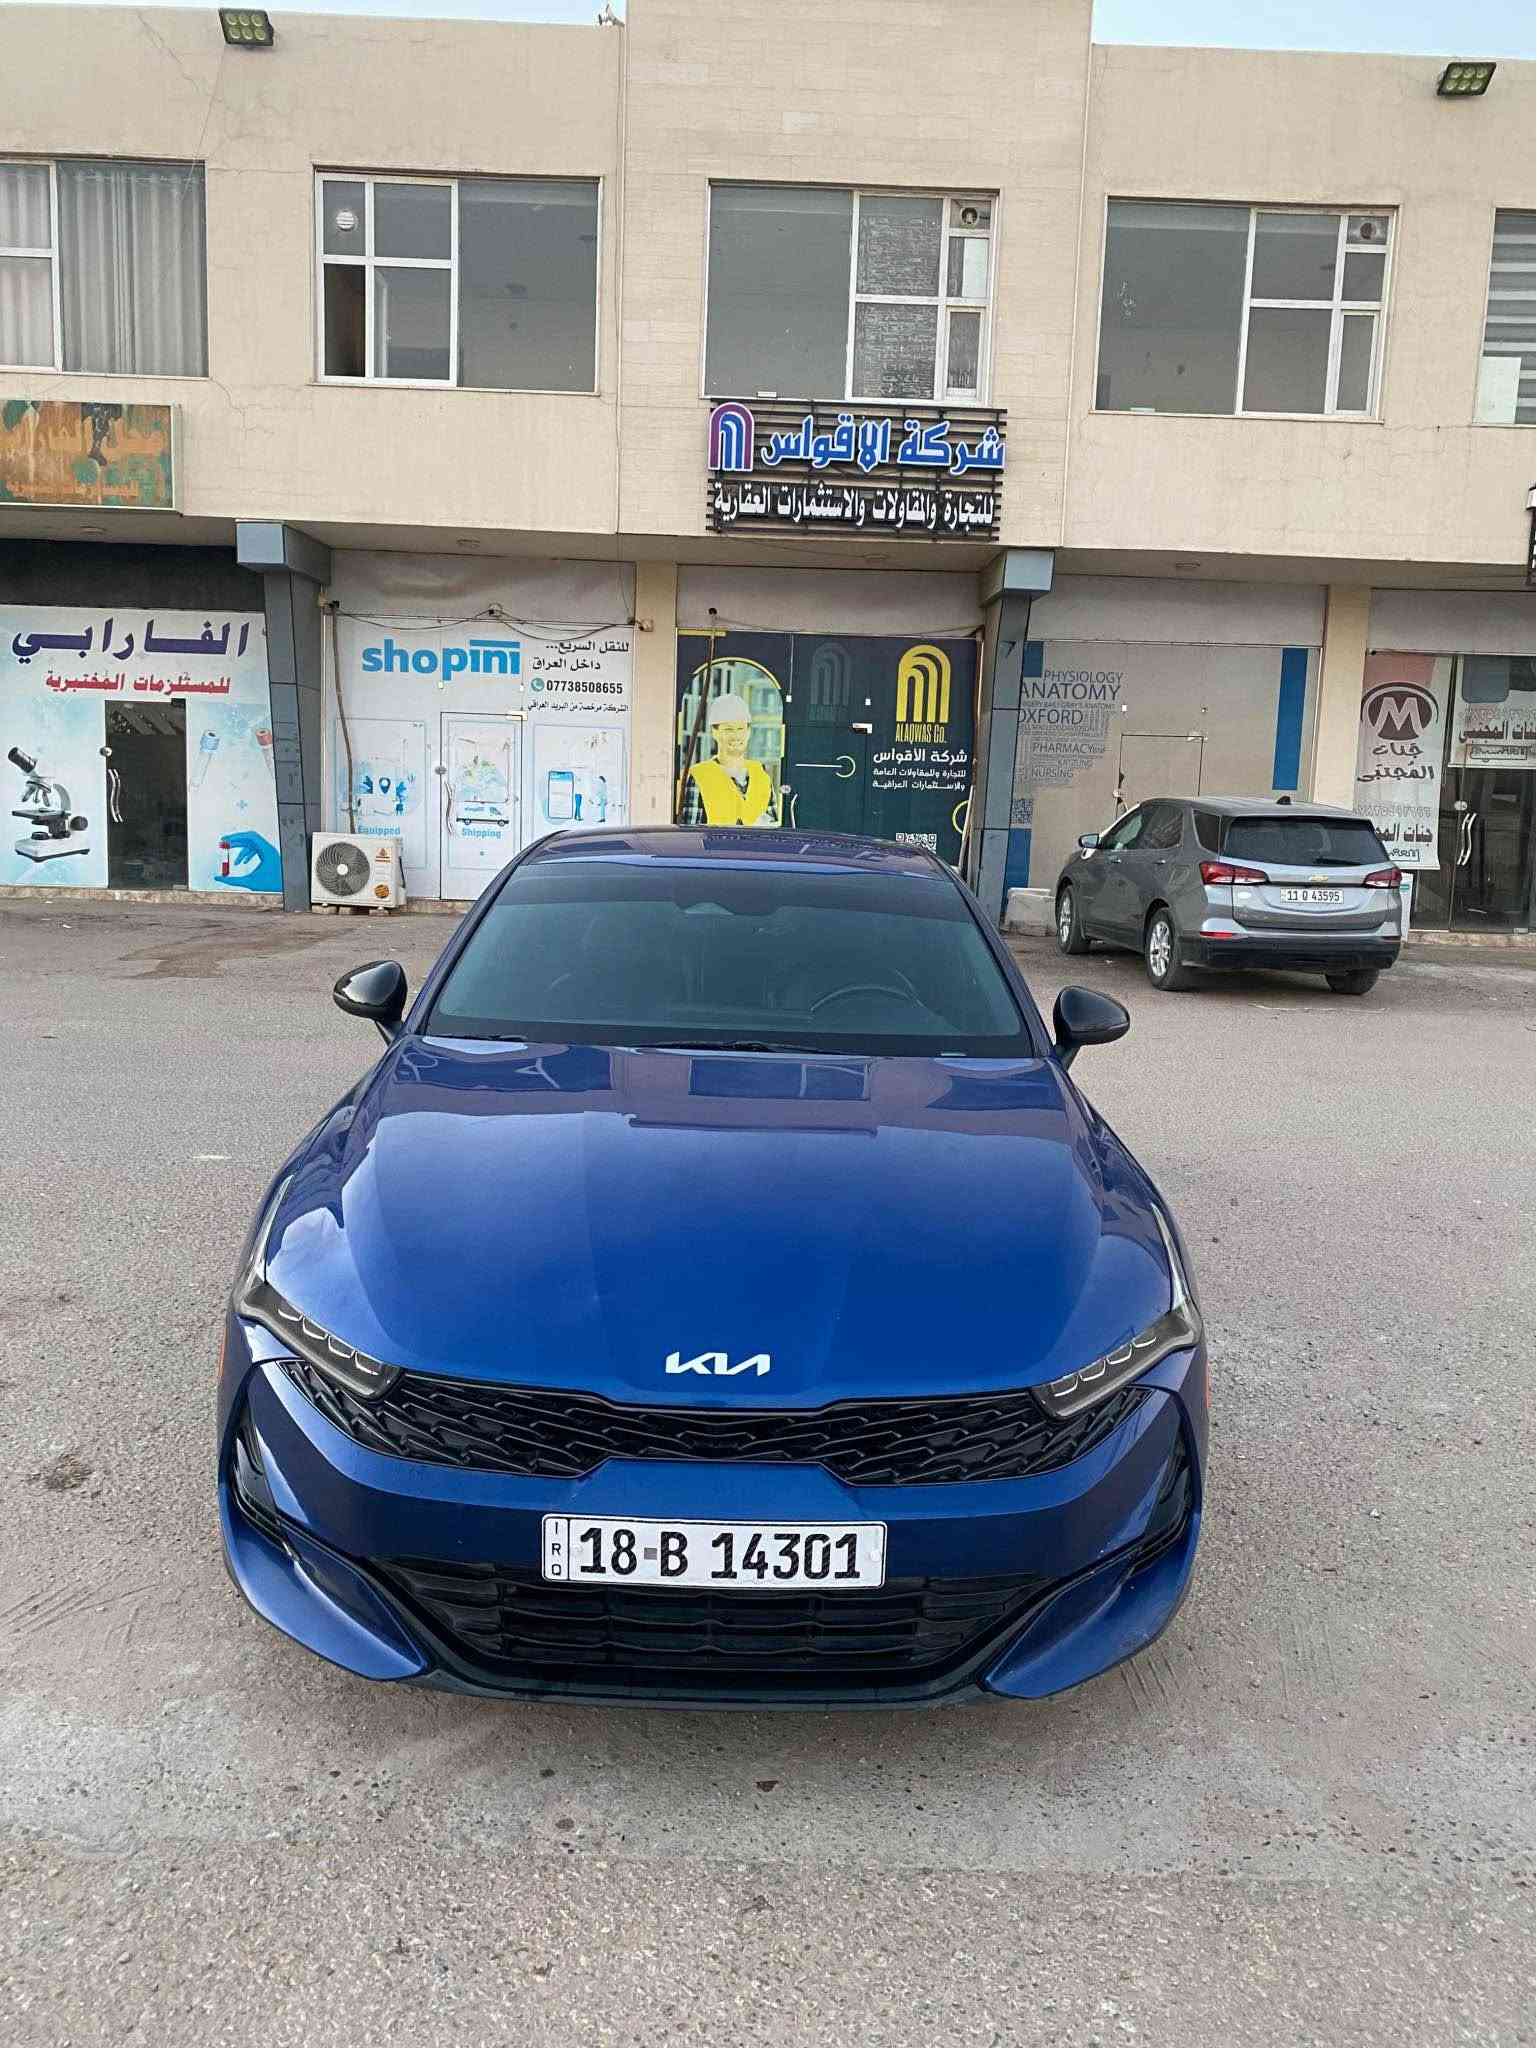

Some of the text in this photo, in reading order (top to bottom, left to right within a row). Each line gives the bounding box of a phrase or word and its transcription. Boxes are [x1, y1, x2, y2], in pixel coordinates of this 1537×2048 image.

[897, 419, 1005, 475] شركة
[714, 481, 994, 532] للتجارة والمقاولات والاستثمارات العقارية
[12, 617, 250, 664] الفارابي
[599, 641, 630, 654] للنقل
[362, 639, 520, 681] shopini
[532, 656, 601, 671] داخل العراق
[46, 671, 231, 695] للمستلزمات المختبرية
[1044, 670, 1123, 684] PHYSIOLOGY
[546, 680, 623, 695] 07738508655
[1021, 683, 1121, 701] ANATOMY
[895, 723, 932, 744] ALAQWAS
[1512, 720, 1536, 740] نات
[930, 749, 967, 765] شركة
[1033, 743, 1094, 754] PHARMACY
[942, 769, 966, 779] للتجارة
[461, 828, 502, 839] Shipping
[1376, 823, 1434, 847] جنات المج
[1287, 890, 1298, 901] 11
[1311, 890, 1340, 901] 43595
[665, 1351, 770, 1376] KIA
[711, 1532, 861, 1580] 14301
